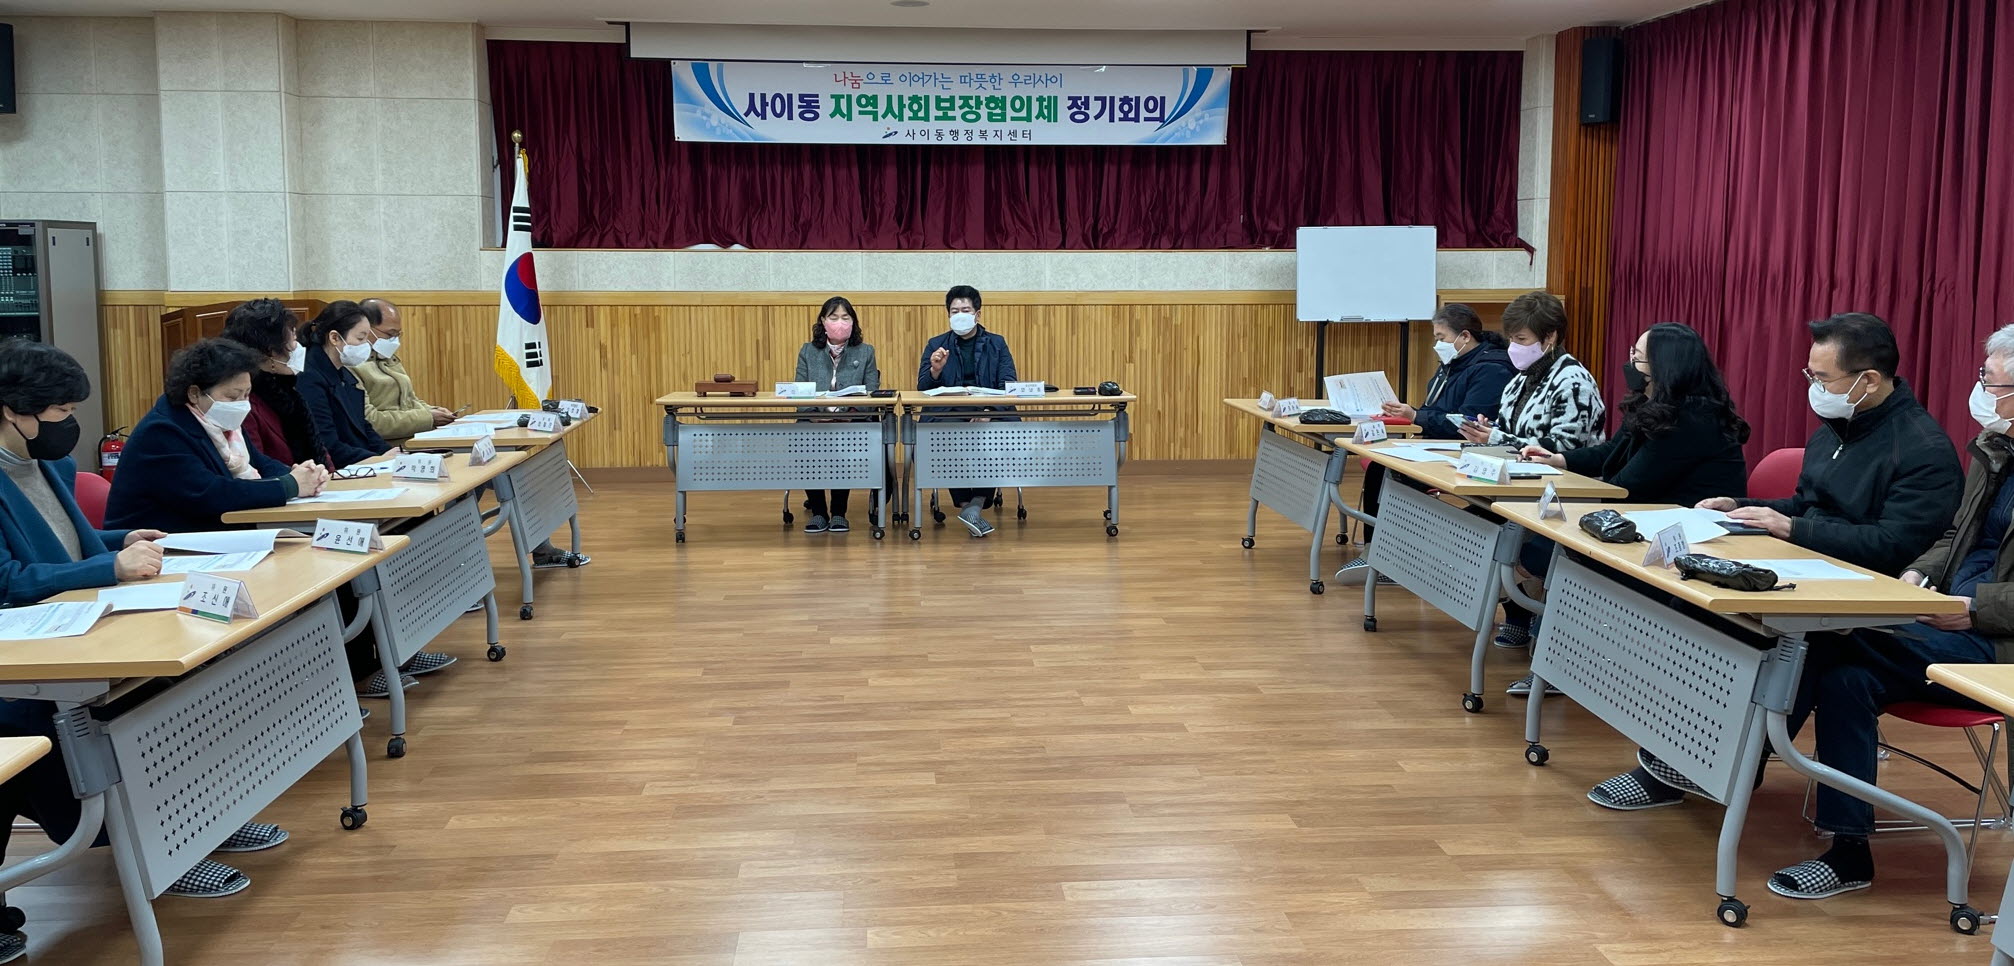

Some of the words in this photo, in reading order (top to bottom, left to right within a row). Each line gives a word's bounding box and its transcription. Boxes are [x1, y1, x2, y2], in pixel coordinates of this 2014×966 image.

[833, 71, 894, 89] 나눔으로
[899, 71, 954, 90] 이어가는
[959, 73, 1004, 90] 따뜻한
[1008, 73, 1063, 89] 우리사이
[743, 92, 821, 121] 사이동
[828, 93, 1058, 123] 지역사회보장협의체
[1066, 95, 1166, 123] 정기회의
[904, 128, 1033, 142] 사이동행정복지센터
